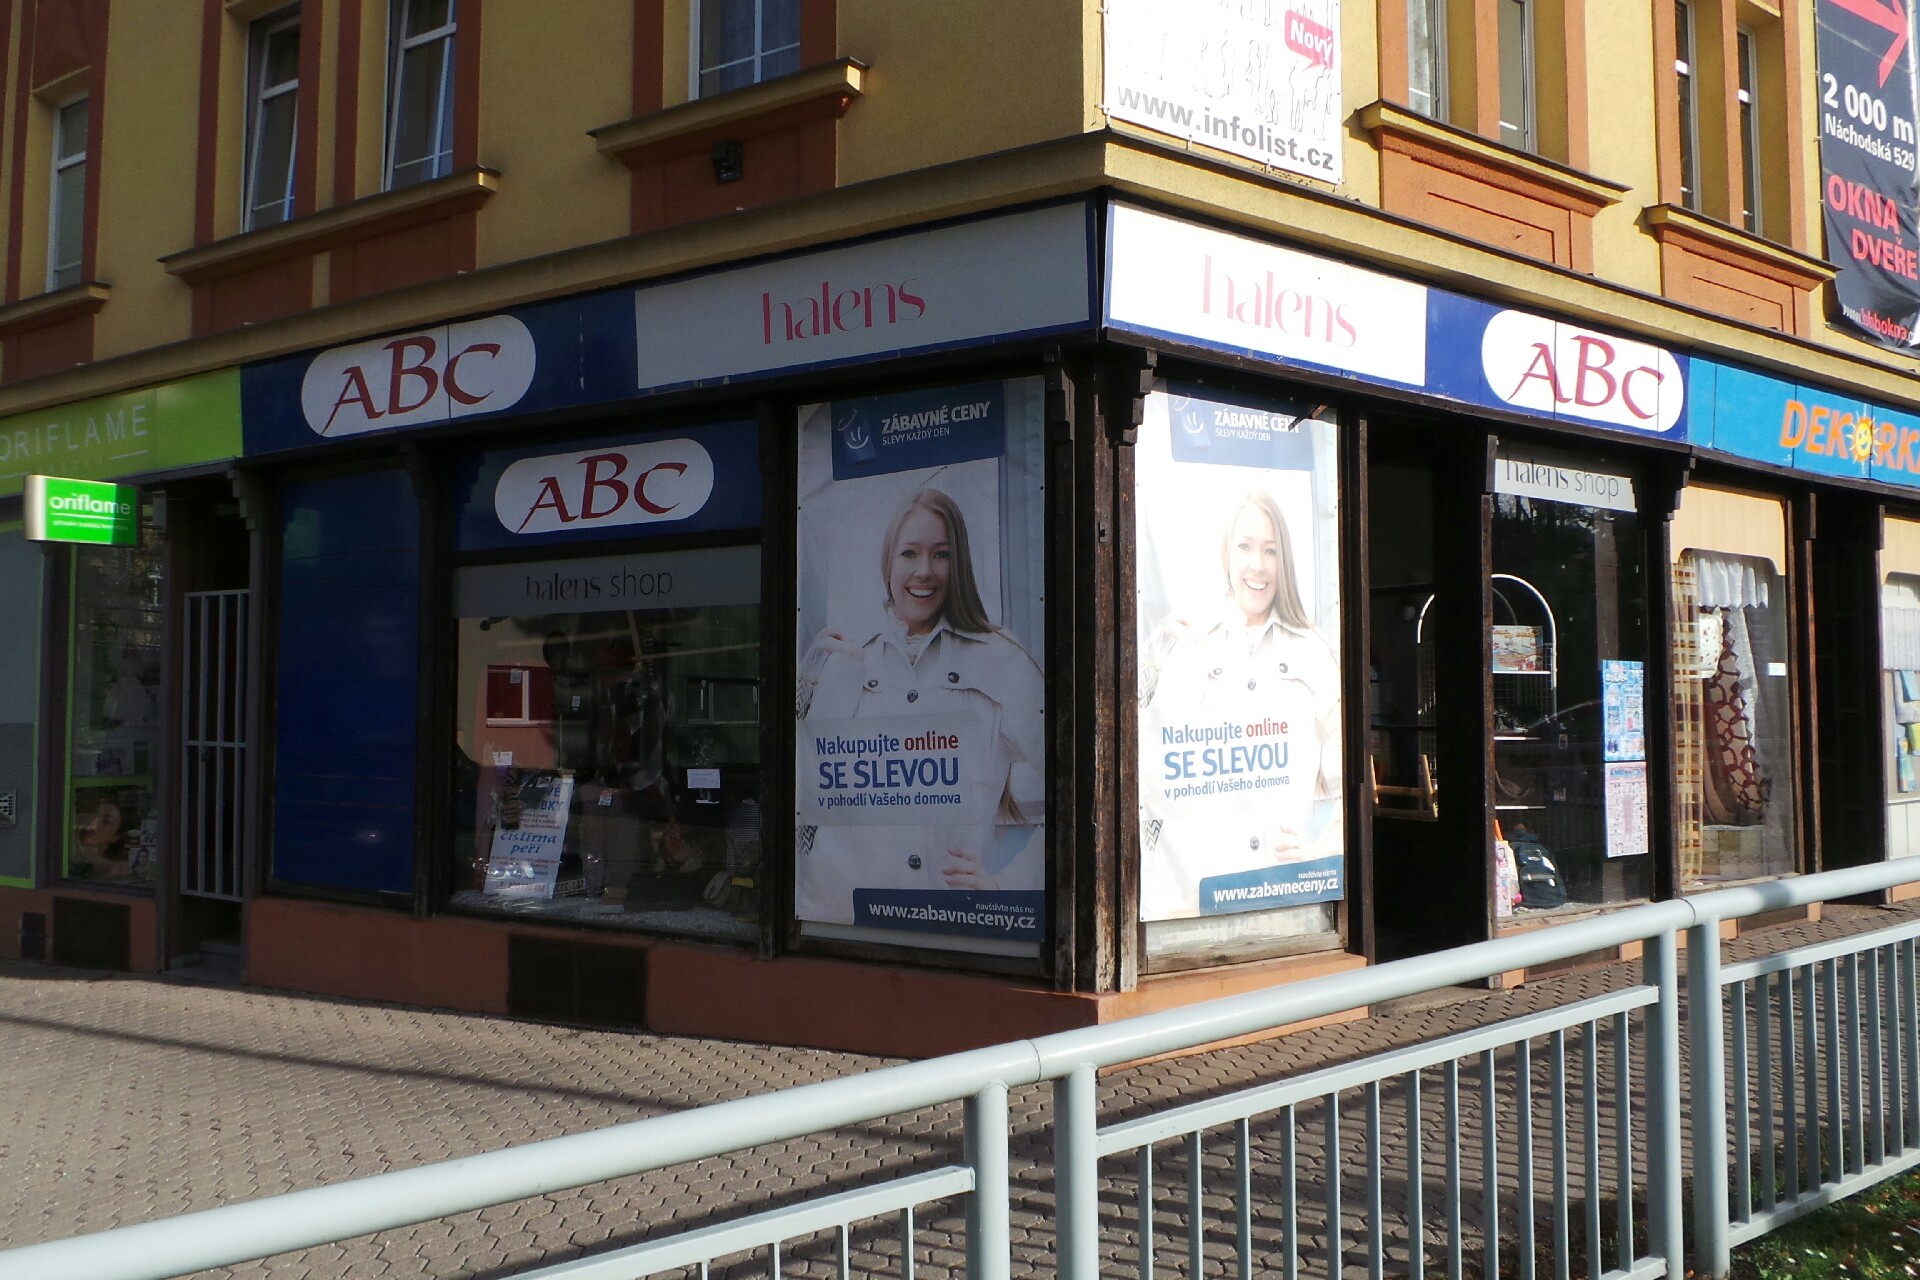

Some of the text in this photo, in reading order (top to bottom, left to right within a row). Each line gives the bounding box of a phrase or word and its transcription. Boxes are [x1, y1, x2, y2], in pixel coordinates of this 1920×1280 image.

[1290, 19, 1333, 62] Nový
[1823, 73, 1914, 144] 2 000 m
[1118, 86, 1334, 171] www.infolist.cz
[1825, 113, 1915, 171] Náchodská 529
[1828, 175, 1900, 234] OKNA
[1852, 228, 1919, 281] DVEŘE
[762, 278, 925, 345] halens
[1202, 254, 1357, 347] halens
[321, 336, 502, 434] ABC
[1508, 335, 1665, 419] ABC
[881, 401, 991, 435] ZÁBAVNÉ CENY
[882, 426, 950, 446] SLEVY KAŽDÝ DEN
[1214, 408, 1270, 431] ZÁBAVNÉ
[1215, 428, 1271, 441] SLEVY KAŽDÝ DEN
[1780, 399, 1920, 475] DEKORK
[517, 453, 688, 534] ABC
[1506, 456, 1619, 498] halens shop
[50, 493, 130, 515] oriflame
[525, 566, 672, 601] halens shop
[816, 731, 959, 758] Nakupujte online
[1162, 718, 1288, 746] Nakupujte online
[819, 757, 959, 789] SE SLEVOU
[1164, 742, 1289, 780] SE SLEVOU
[818, 792, 961, 809] v pohodlí Vašeho domova
[1164, 775, 1290, 801] v pohodlí Vašeho domova
[1213, 877, 1338, 903] www.zabavneceny.cz
[868, 902, 1036, 931] www.zabavneceny.cz
[1010, 904, 1024, 913] nás
